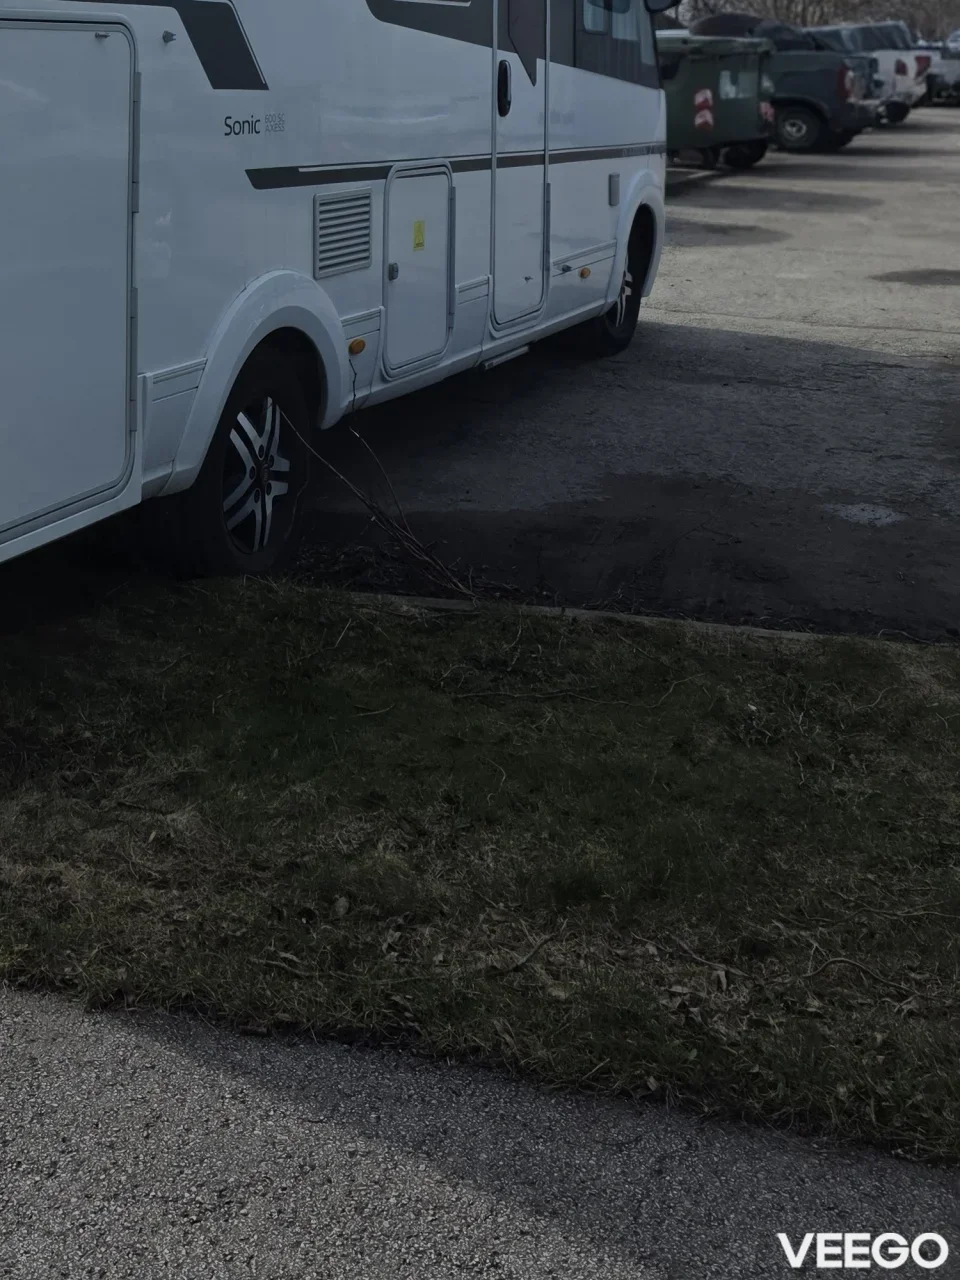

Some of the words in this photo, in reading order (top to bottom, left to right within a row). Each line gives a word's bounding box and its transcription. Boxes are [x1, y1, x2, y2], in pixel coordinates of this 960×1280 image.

[264, 113, 277, 124] 600
[224, 114, 261, 137] Sonic
[264, 122, 286, 133] AXESS
